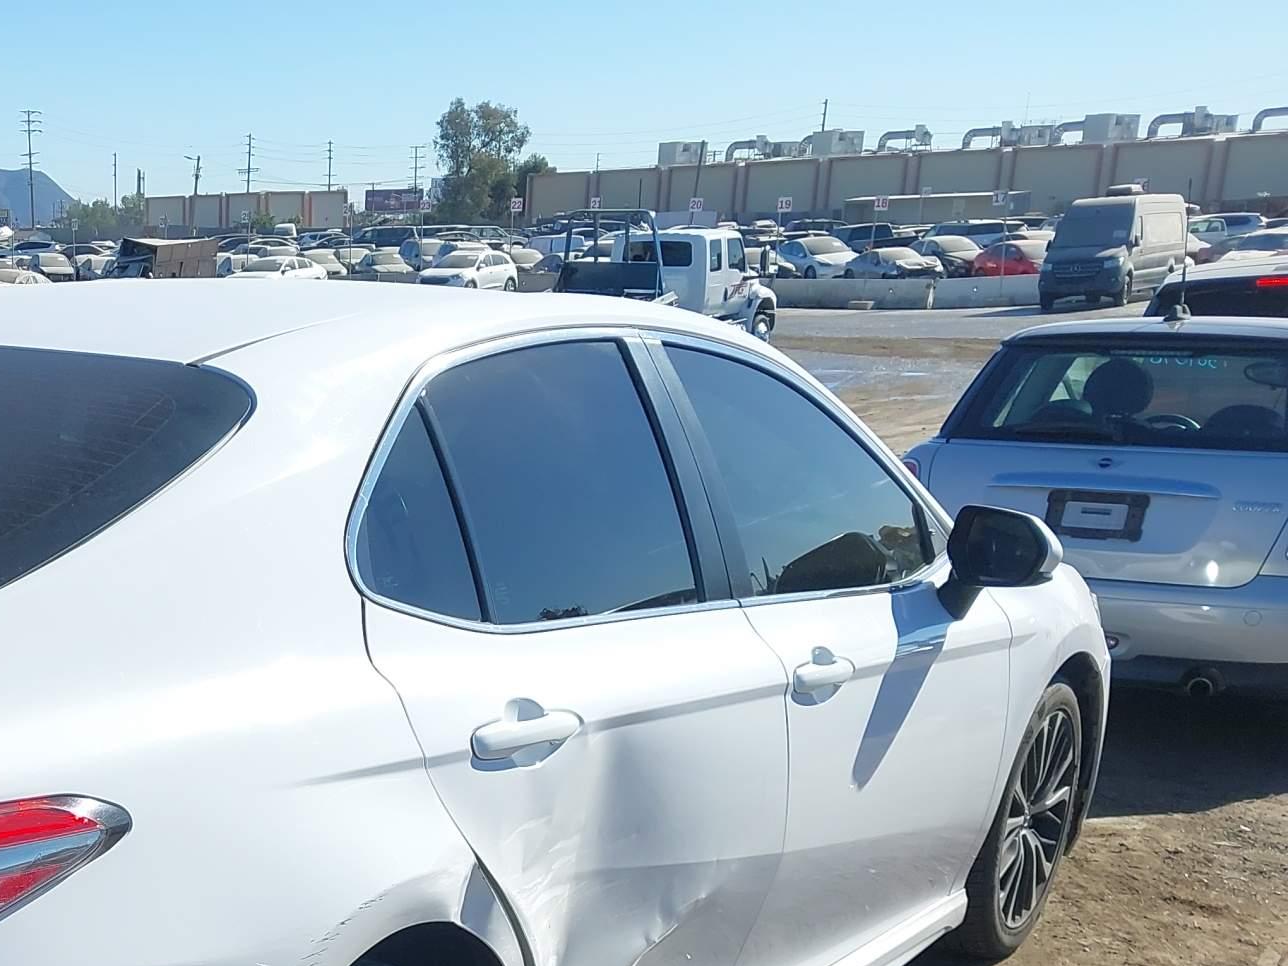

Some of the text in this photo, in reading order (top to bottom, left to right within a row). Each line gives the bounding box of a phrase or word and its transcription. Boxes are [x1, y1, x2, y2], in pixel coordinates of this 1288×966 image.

[512, 200, 522, 209] 22
[690, 200, 702, 209] 20
[778, 200, 791, 209] 19
[875, 199, 888, 208] 18
